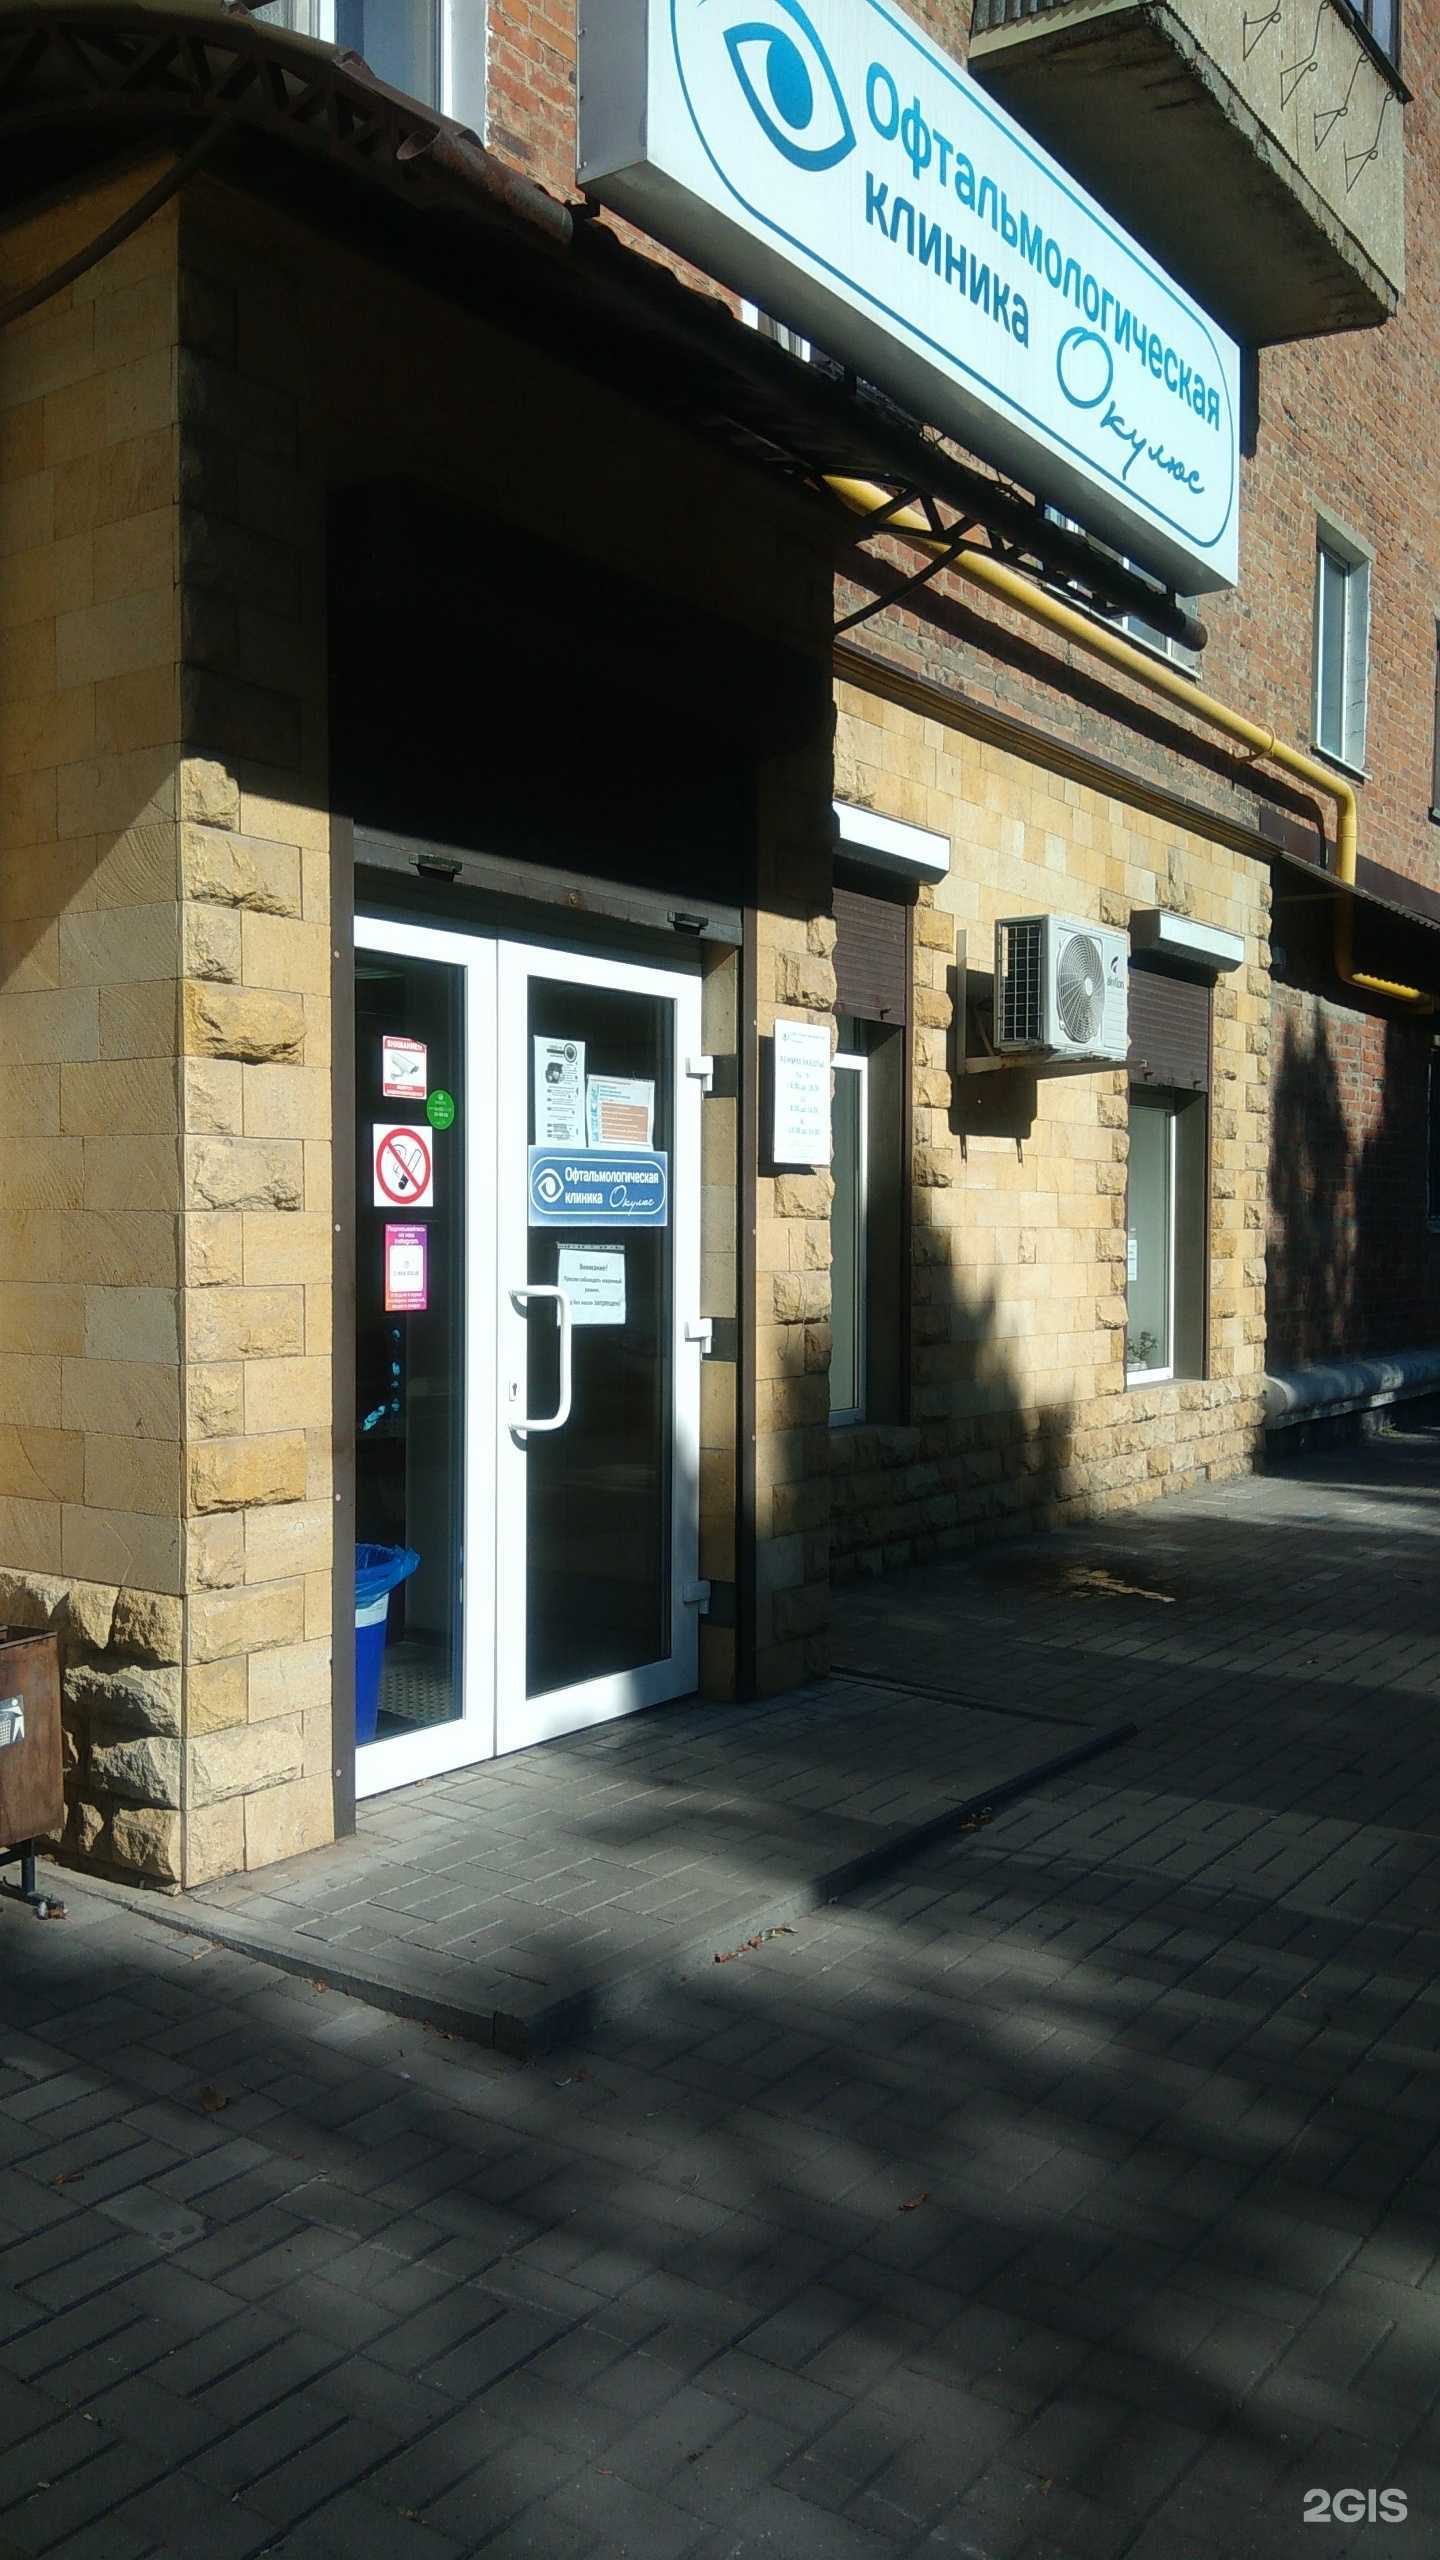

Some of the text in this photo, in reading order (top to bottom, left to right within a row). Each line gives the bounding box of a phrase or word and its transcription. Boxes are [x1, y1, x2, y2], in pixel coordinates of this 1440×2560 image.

[865, 61, 1221, 432] Офтальмологическая
[865, 169, 1206, 495] клиника Окулюс
[564, 1167, 659, 1185] Офтальмологическая
[564, 1184, 656, 1216] клиника Окулюс
